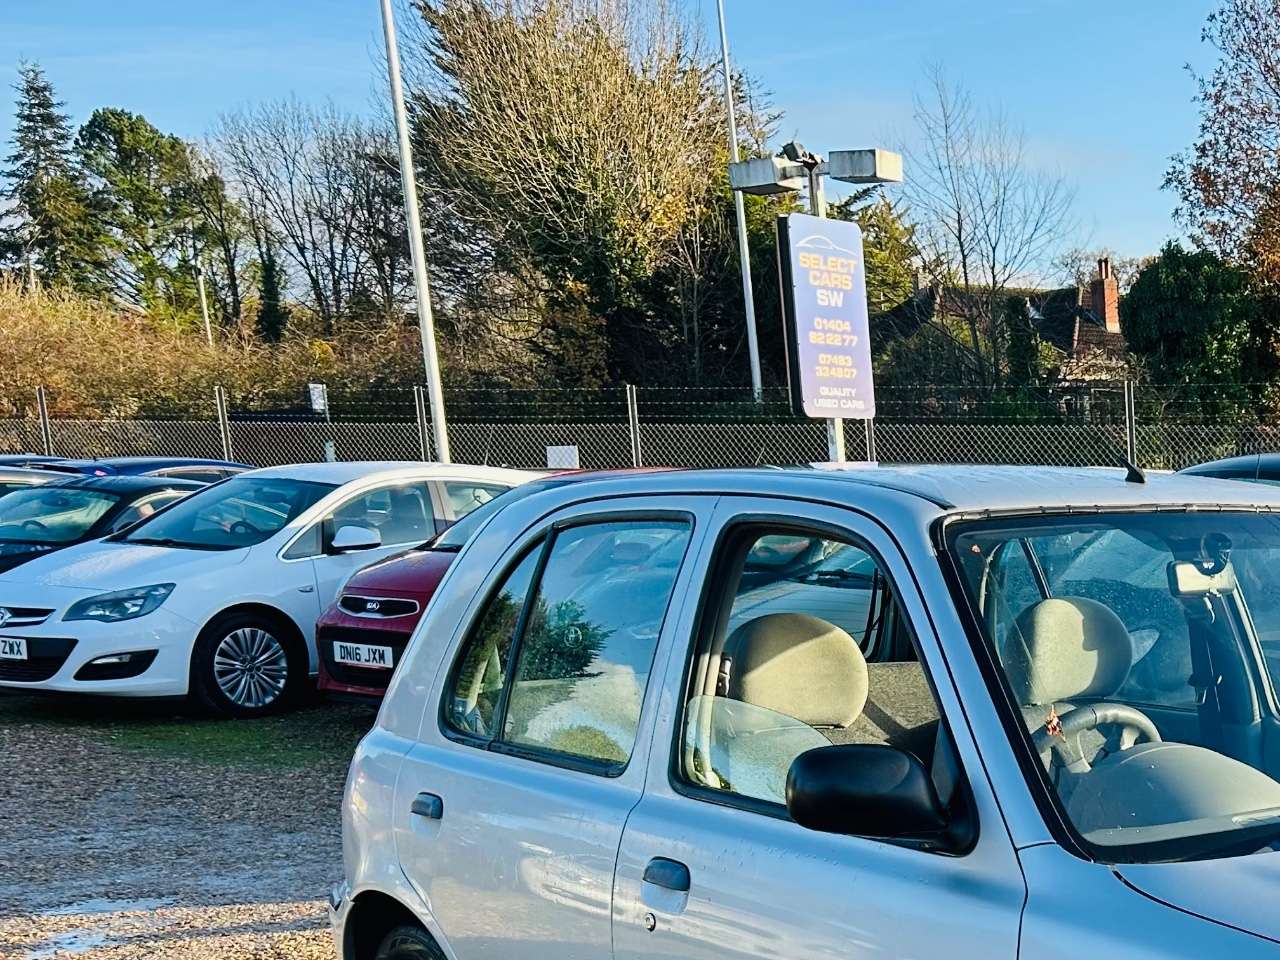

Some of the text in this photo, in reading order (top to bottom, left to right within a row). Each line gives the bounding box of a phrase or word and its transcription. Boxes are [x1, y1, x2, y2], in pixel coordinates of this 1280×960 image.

[799, 252, 857, 274] SELECT
[809, 270, 853, 289] CARS
[816, 288, 844, 307] SW
[819, 386, 857, 397] QUALITY
[339, 645, 386, 665] DN16 JXM
